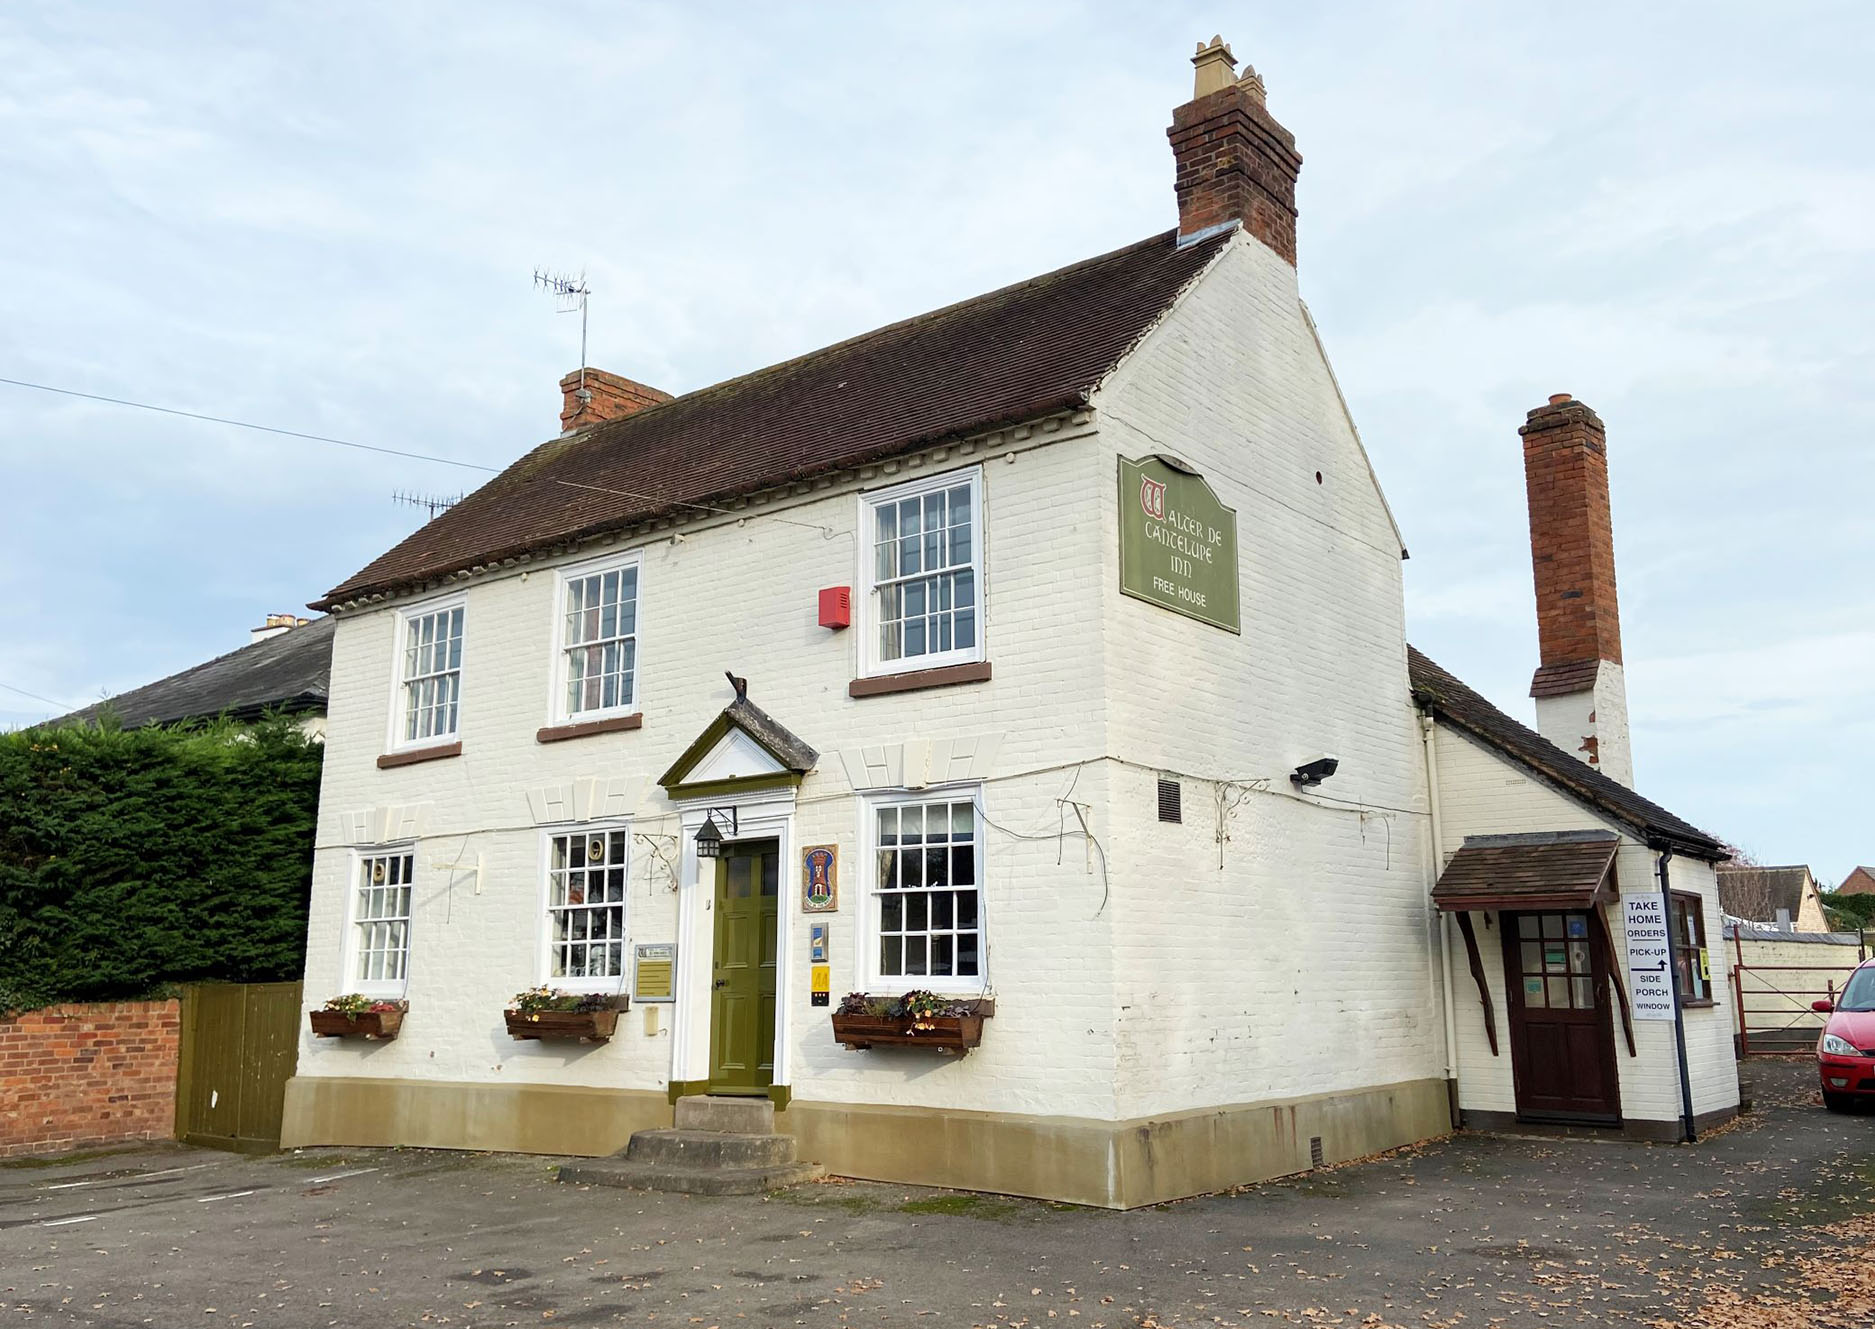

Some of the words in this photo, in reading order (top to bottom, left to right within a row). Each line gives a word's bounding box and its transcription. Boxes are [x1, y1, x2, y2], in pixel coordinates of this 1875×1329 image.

[1140, 472, 1203, 538] WALTER
[1208, 527, 1222, 546] DE
[1145, 521, 1213, 564] CANTELUPE
[1170, 555, 1192, 578] INN
[1153, 576, 1175, 596] FREE
[1177, 585, 1207, 608] HOUSE
[1628, 901, 1659, 911] TAKE
[1628, 915, 1662, 924] HOME
[1627, 929, 1666, 938] ORDERS
[1629, 948, 1667, 957] PICK-UP
[1640, 974, 1662, 983] SIDE
[1635, 988, 1669, 997] PORCH
